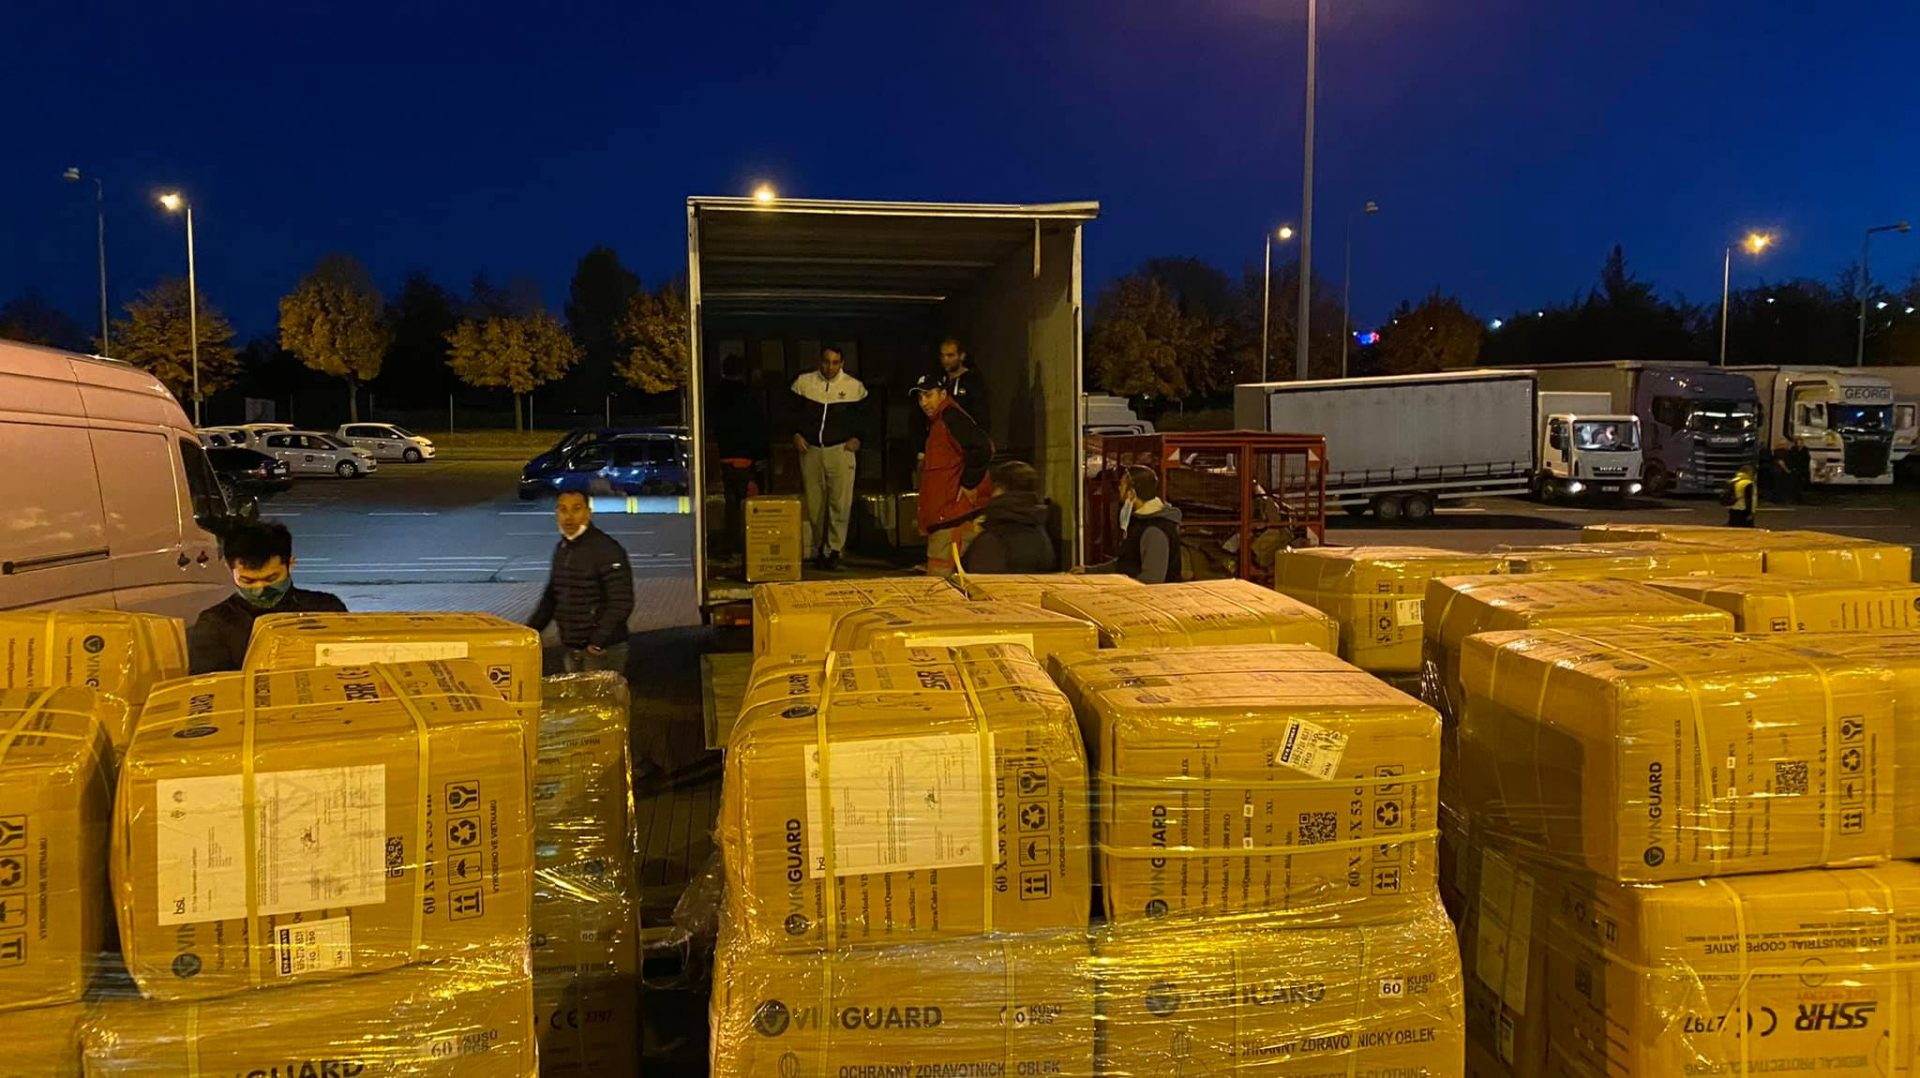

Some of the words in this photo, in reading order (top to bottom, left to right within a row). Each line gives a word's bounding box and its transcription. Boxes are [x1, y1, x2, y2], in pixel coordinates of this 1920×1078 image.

[1845, 387, 1890, 400] GEORGI
[1350, 799, 1363, 817] 53
[1648, 761, 1663, 847] VINGUARD
[1349, 821, 1362, 832] X
[786, 818, 804, 915] VINGUARD
[422, 896, 436, 915] 60
[1703, 940, 1787, 956] COOPEATIVE
[1789, 937, 1858, 951] INDUSTRIAL
[1380, 983, 1402, 996] 60
[1794, 1001, 1879, 1033] SSHR
[1300, 1030, 1396, 1053] ZDRAVONICKÝ
[1396, 1028, 1436, 1046] OBLEK
[915, 1060, 1007, 1078] ZDRAVOTNICK
